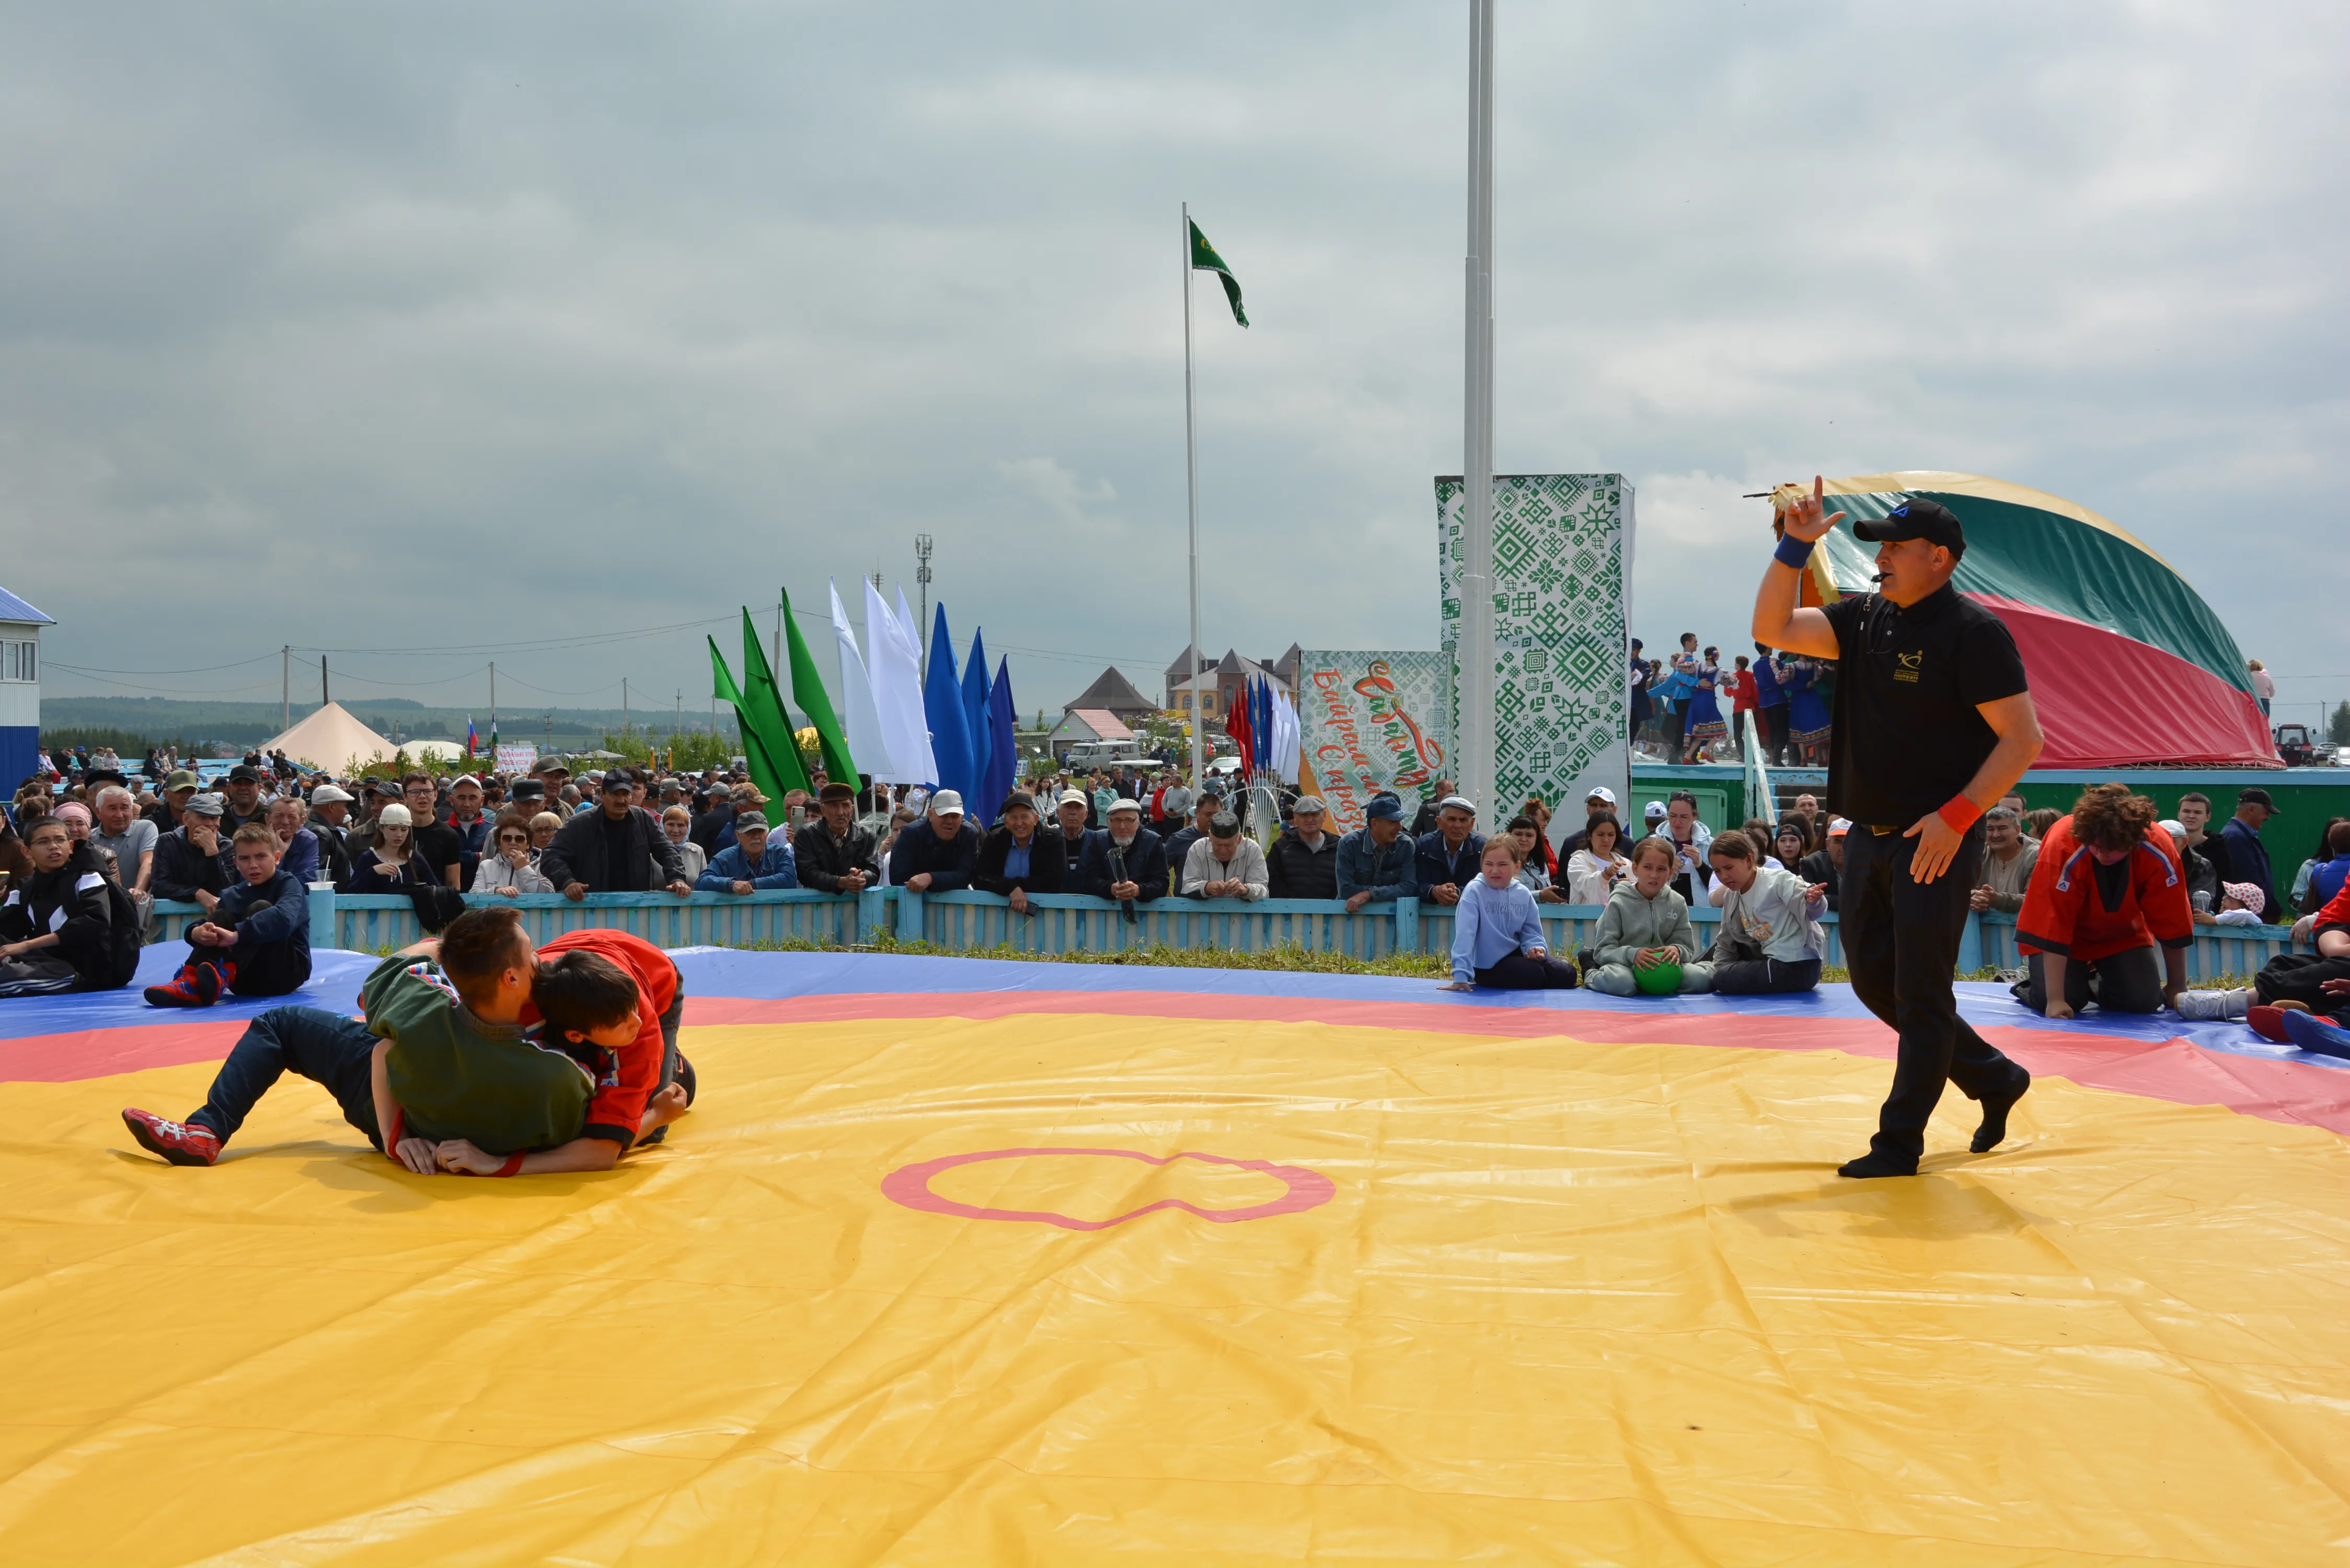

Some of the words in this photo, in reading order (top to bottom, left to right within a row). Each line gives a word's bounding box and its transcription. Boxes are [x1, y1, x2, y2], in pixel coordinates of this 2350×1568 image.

[1314, 668, 1370, 767] Байрам
[1318, 745, 1345, 761] С
[1667, 909, 1677, 919] alo
